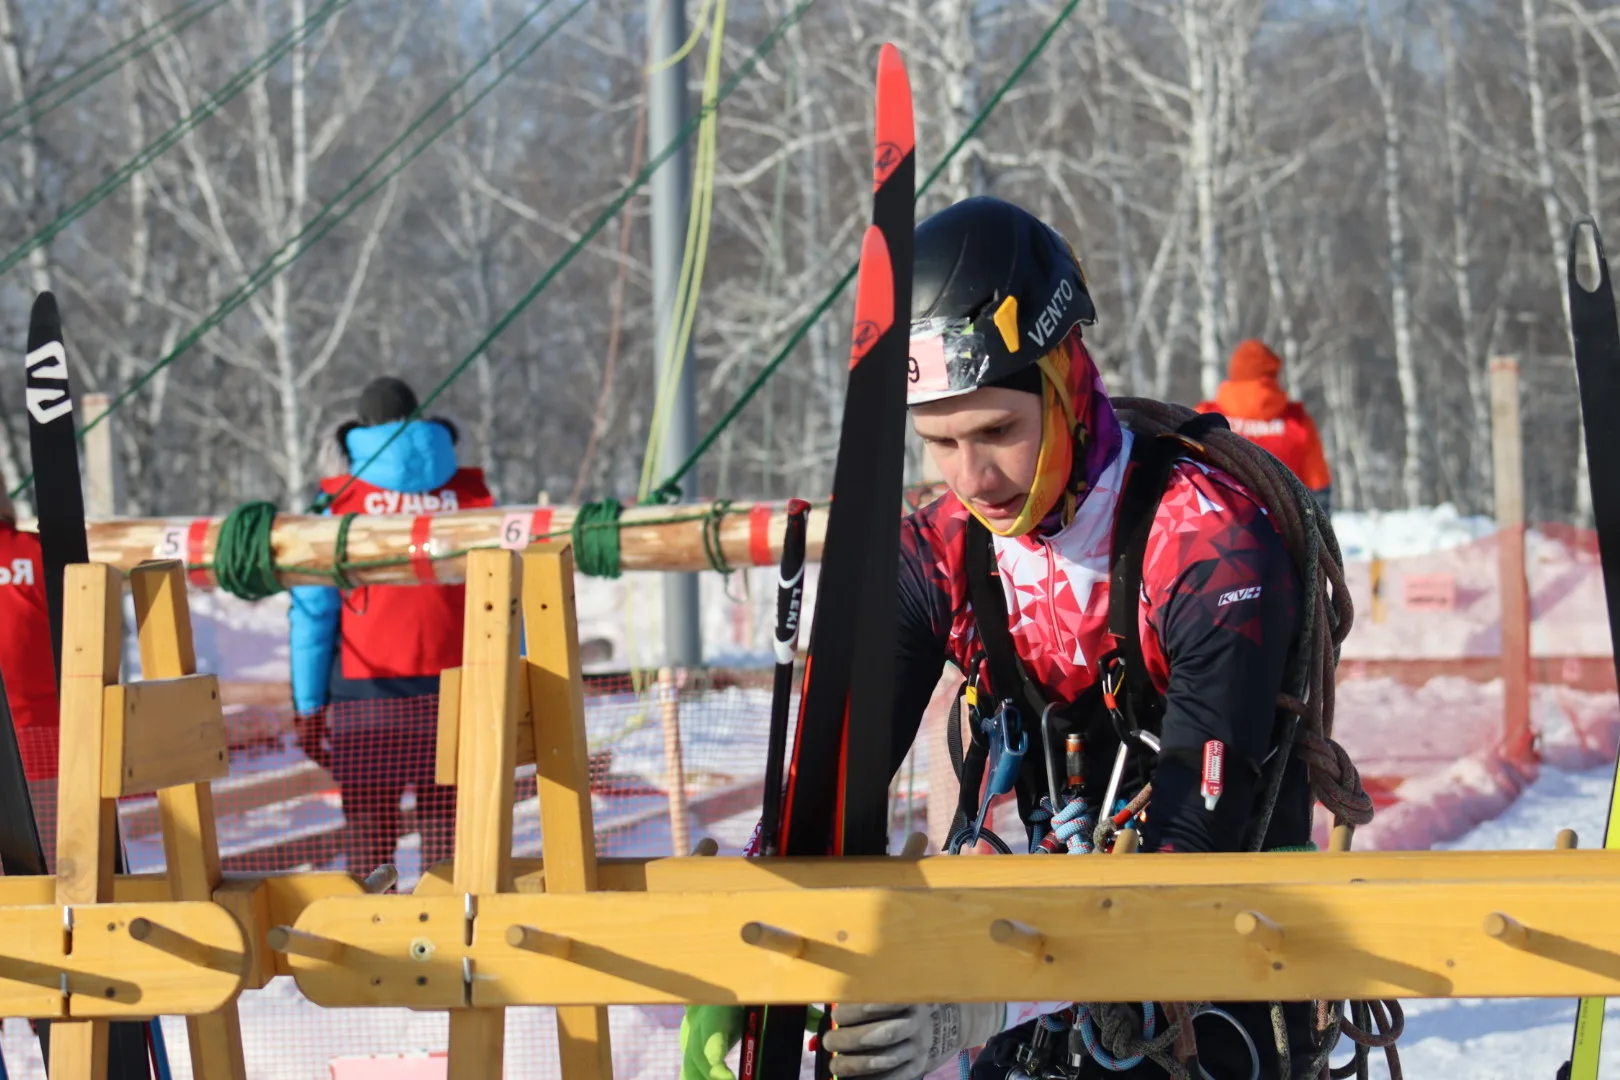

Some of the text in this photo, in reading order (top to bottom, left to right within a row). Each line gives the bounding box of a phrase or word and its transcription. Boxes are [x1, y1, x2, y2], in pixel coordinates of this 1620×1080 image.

[1027, 279, 1073, 347] VENTO
[165, 531, 181, 555] 5
[506, 519, 521, 543] 6
[785, 587, 801, 630] LEKI
